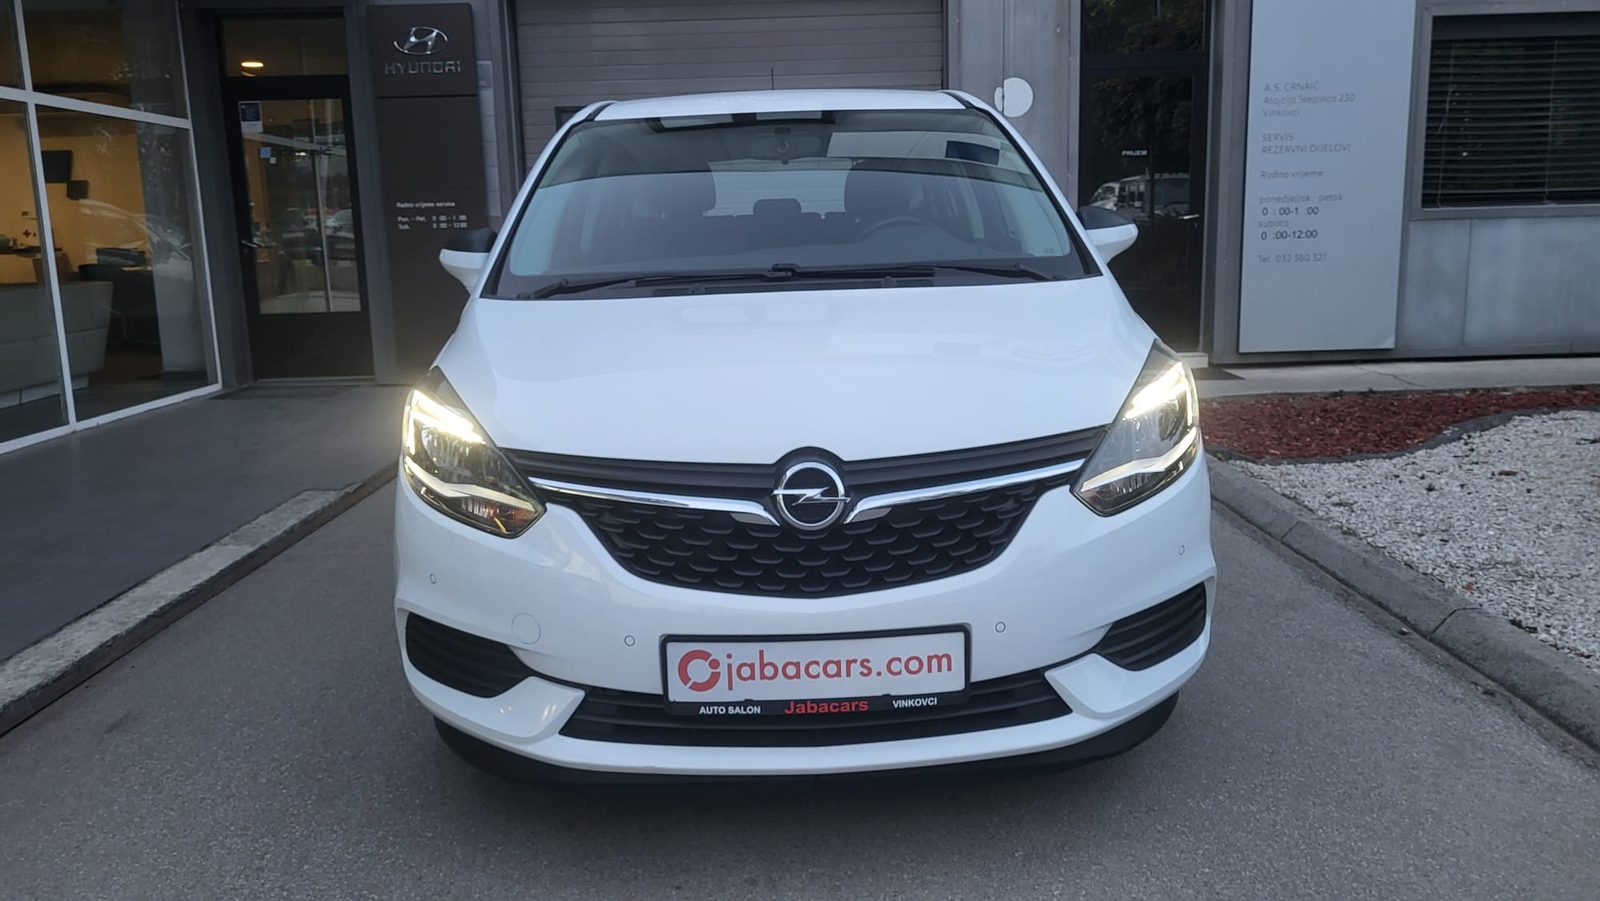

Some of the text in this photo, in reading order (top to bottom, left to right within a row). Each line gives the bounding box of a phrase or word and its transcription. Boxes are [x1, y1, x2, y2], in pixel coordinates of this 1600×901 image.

[385, 61, 461, 74] HYUNDAI
[1262, 133, 1294, 142] SERVIS
[1261, 143, 1351, 154] REZERVNI DIJELOVI
[726, 649, 953, 691] jabacars.com
[699, 697, 938, 715] AUTO SALON Jabacars VINKOVCI
